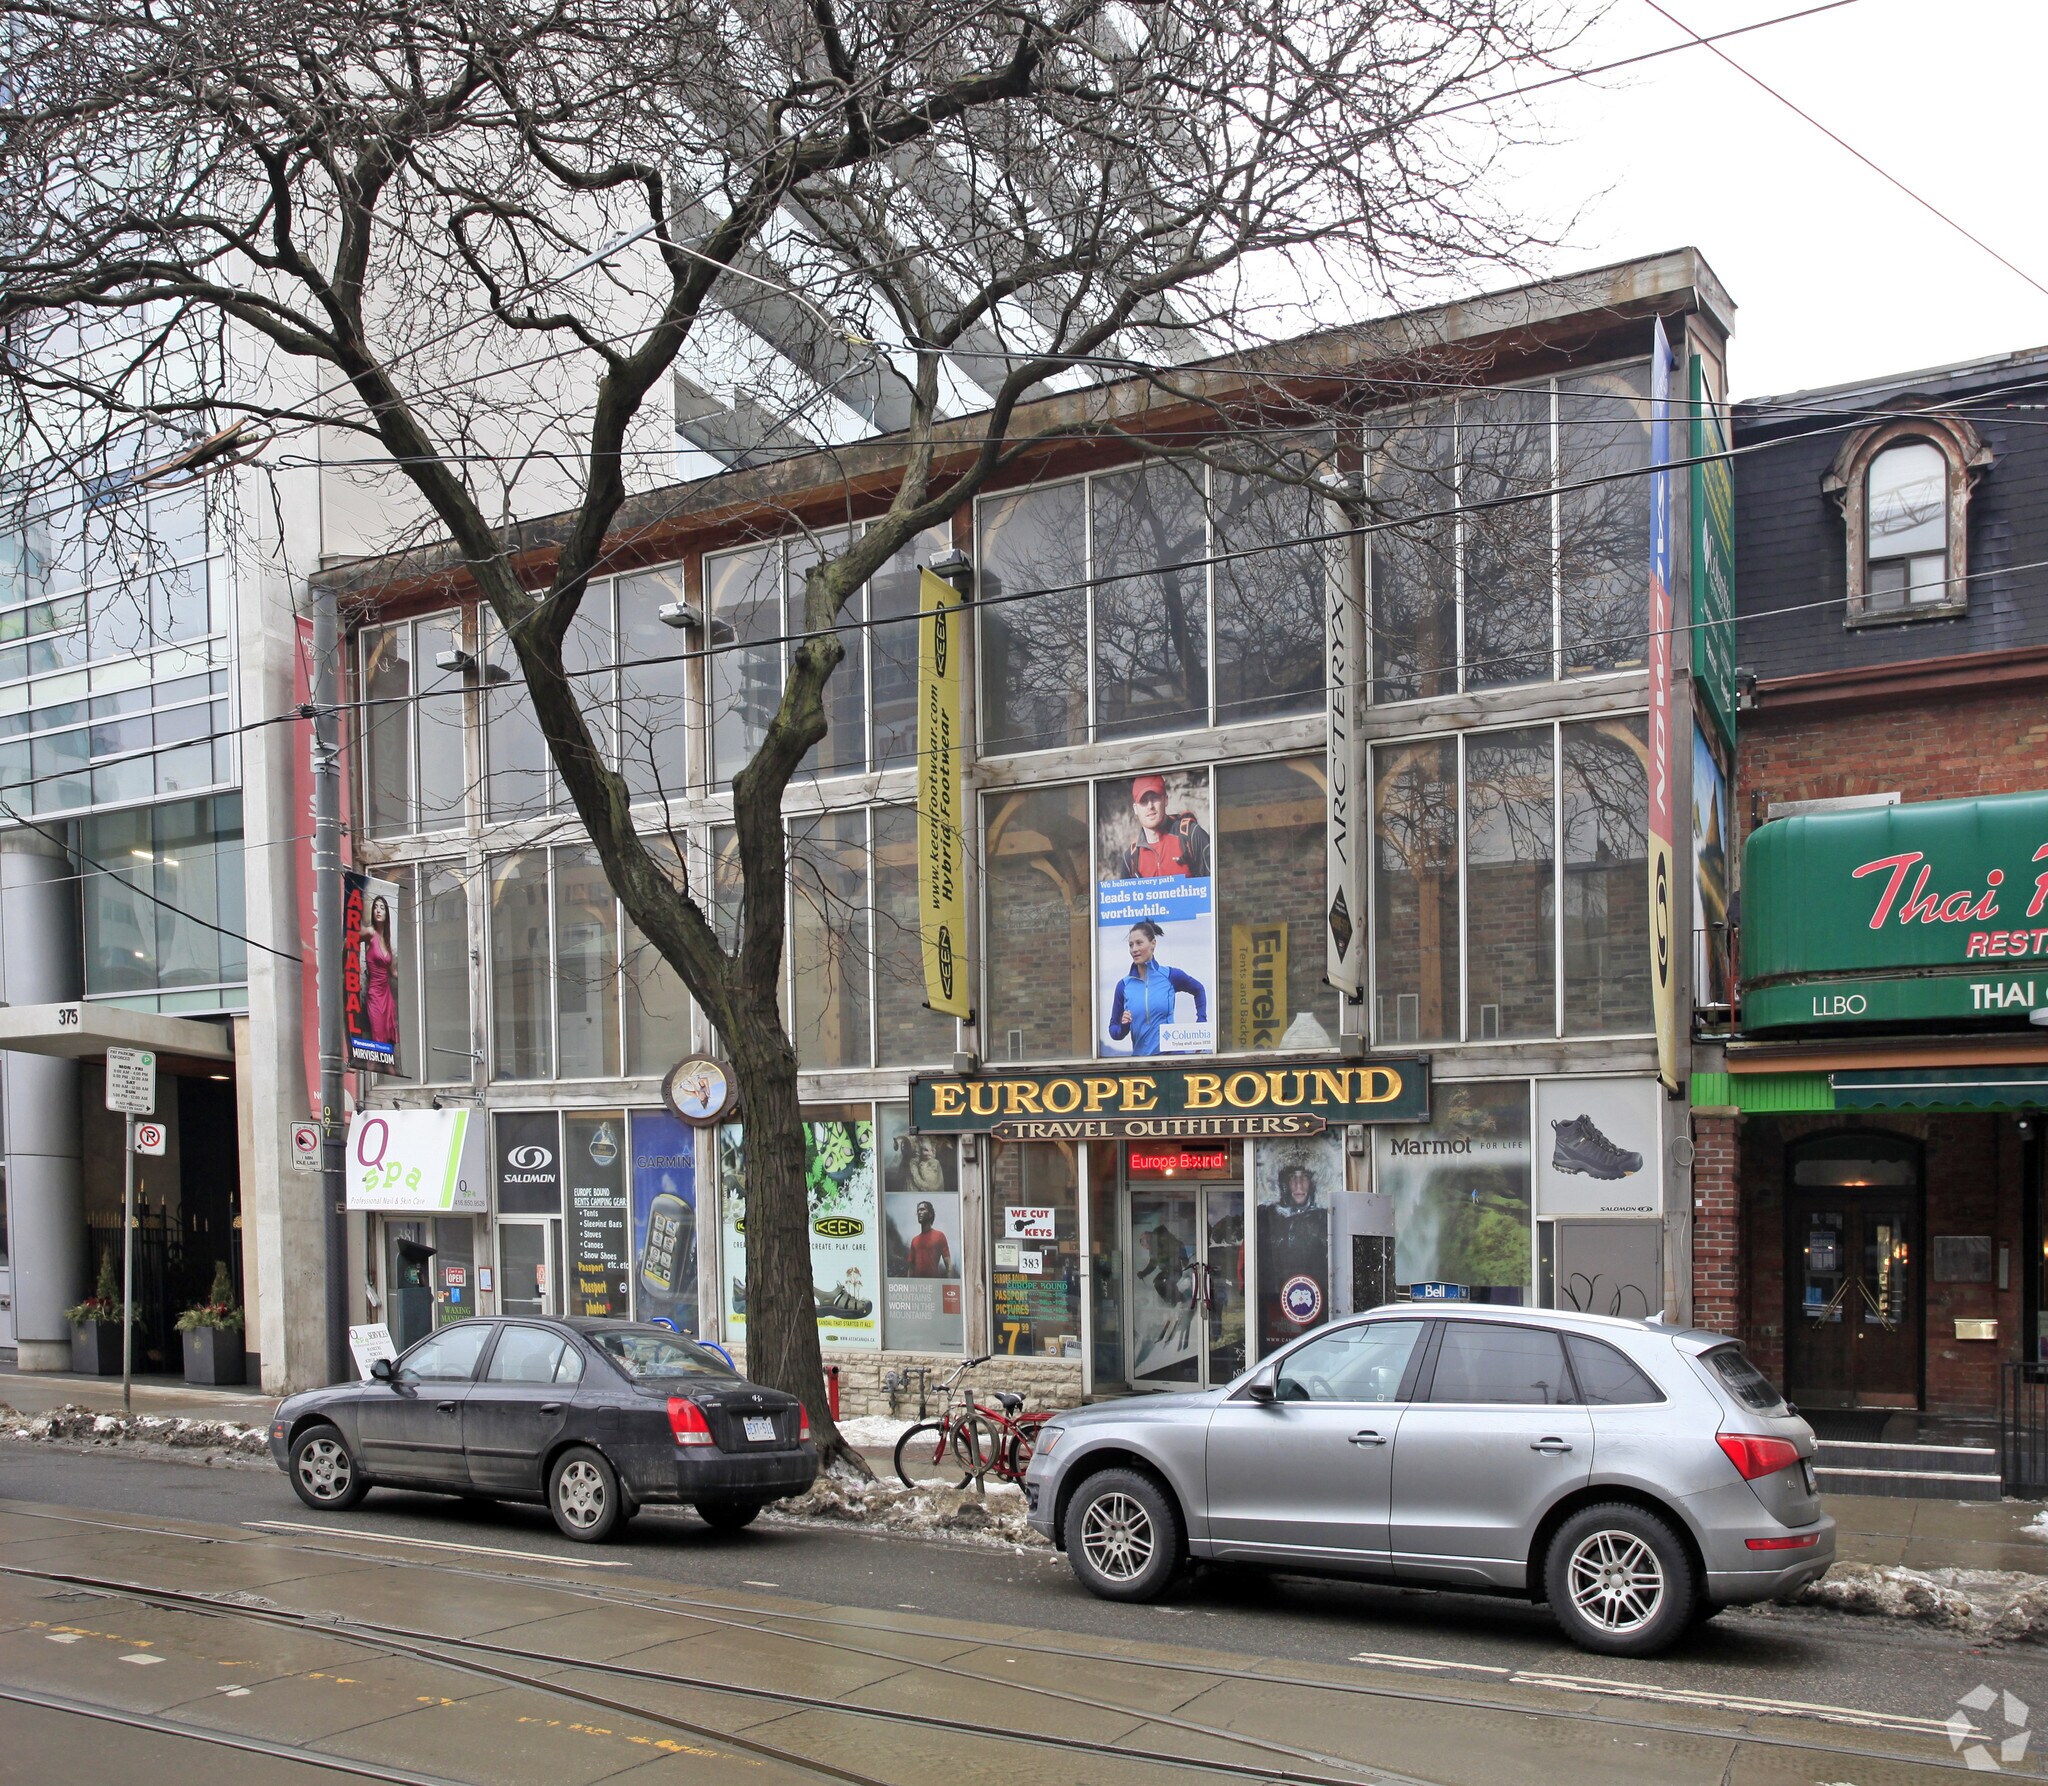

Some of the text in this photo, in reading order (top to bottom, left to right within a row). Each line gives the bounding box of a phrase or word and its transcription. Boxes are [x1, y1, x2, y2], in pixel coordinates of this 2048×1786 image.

[1332, 591, 1347, 866] ARC'TERYX
[940, 708, 954, 901] Hybrid Footwear
[1112, 880, 1136, 888] believe
[1138, 878, 1158, 886] every
[1159, 876, 1174, 885] path
[1100, 884, 1207, 904] leads to something
[1852, 852, 2004, 929] Thai
[1101, 903, 1170, 920] worthwhile.
[344, 888, 363, 1034] ARRABAL
[940, 926, 952, 996] KEEN
[1240, 946, 1250, 1047] Tents and Backp
[1970, 982, 2034, 1009] THAI
[1813, 994, 1867, 1016] LLBO
[58, 1008, 78, 1025] 375
[1172, 1030, 1211, 1040] Columbia
[352, 1047, 394, 1065] MIRVISH.COM
[930, 1066, 1403, 1116] EUROPE BOUND
[1012, 1116, 1300, 1138] TRAVEL OUTFITTERS
[358, 1118, 388, 1171] Q
[1390, 1136, 1472, 1156] Marmot
[1131, 1153, 1222, 1170] Europe Bound
[364, 1161, 422, 1192] spa
[504, 1174, 556, 1183] SALOMON
[459, 1180, 468, 1192] Q
[574, 1188, 610, 1196] EUROPE BOUND
[350, 1196, 381, 1205] Professional
[574, 1198, 627, 1206] RENTS CAMPING GEAR
[583, 1209, 598, 1217] Tents
[1011, 1210, 1050, 1218] WE CUT
[584, 1220, 622, 1228] Sleeping Bags
[816, 1220, 862, 1234] KEEN
[584, 1230, 602, 1238] Stoves
[1025, 1228, 1052, 1237] KEYS
[584, 1240, 604, 1249] Canoes
[584, 1251, 617, 1260] Snow Shoes
[578, 1262, 604, 1275] Passport
[1022, 1258, 1040, 1269] 383
[448, 1274, 464, 1283] OPEN
[580, 1278, 606, 1298] Passport
[888, 1284, 908, 1292] BORN
[918, 1284, 932, 1293] THE
[1425, 1284, 1446, 1298] Bell
[888, 1293, 932, 1302] MOUNTAINS
[994, 1290, 1028, 1300] PASSPORT
[444, 1306, 471, 1314] WAXING
[586, 1300, 606, 1316] photos
[888, 1302, 910, 1310] WORN
[920, 1303, 936, 1311] THE
[996, 1304, 1029, 1315] PICTURES
[890, 1310, 932, 1320] MOUNTAINS
[998, 1322, 1030, 1356] $ 7 99
